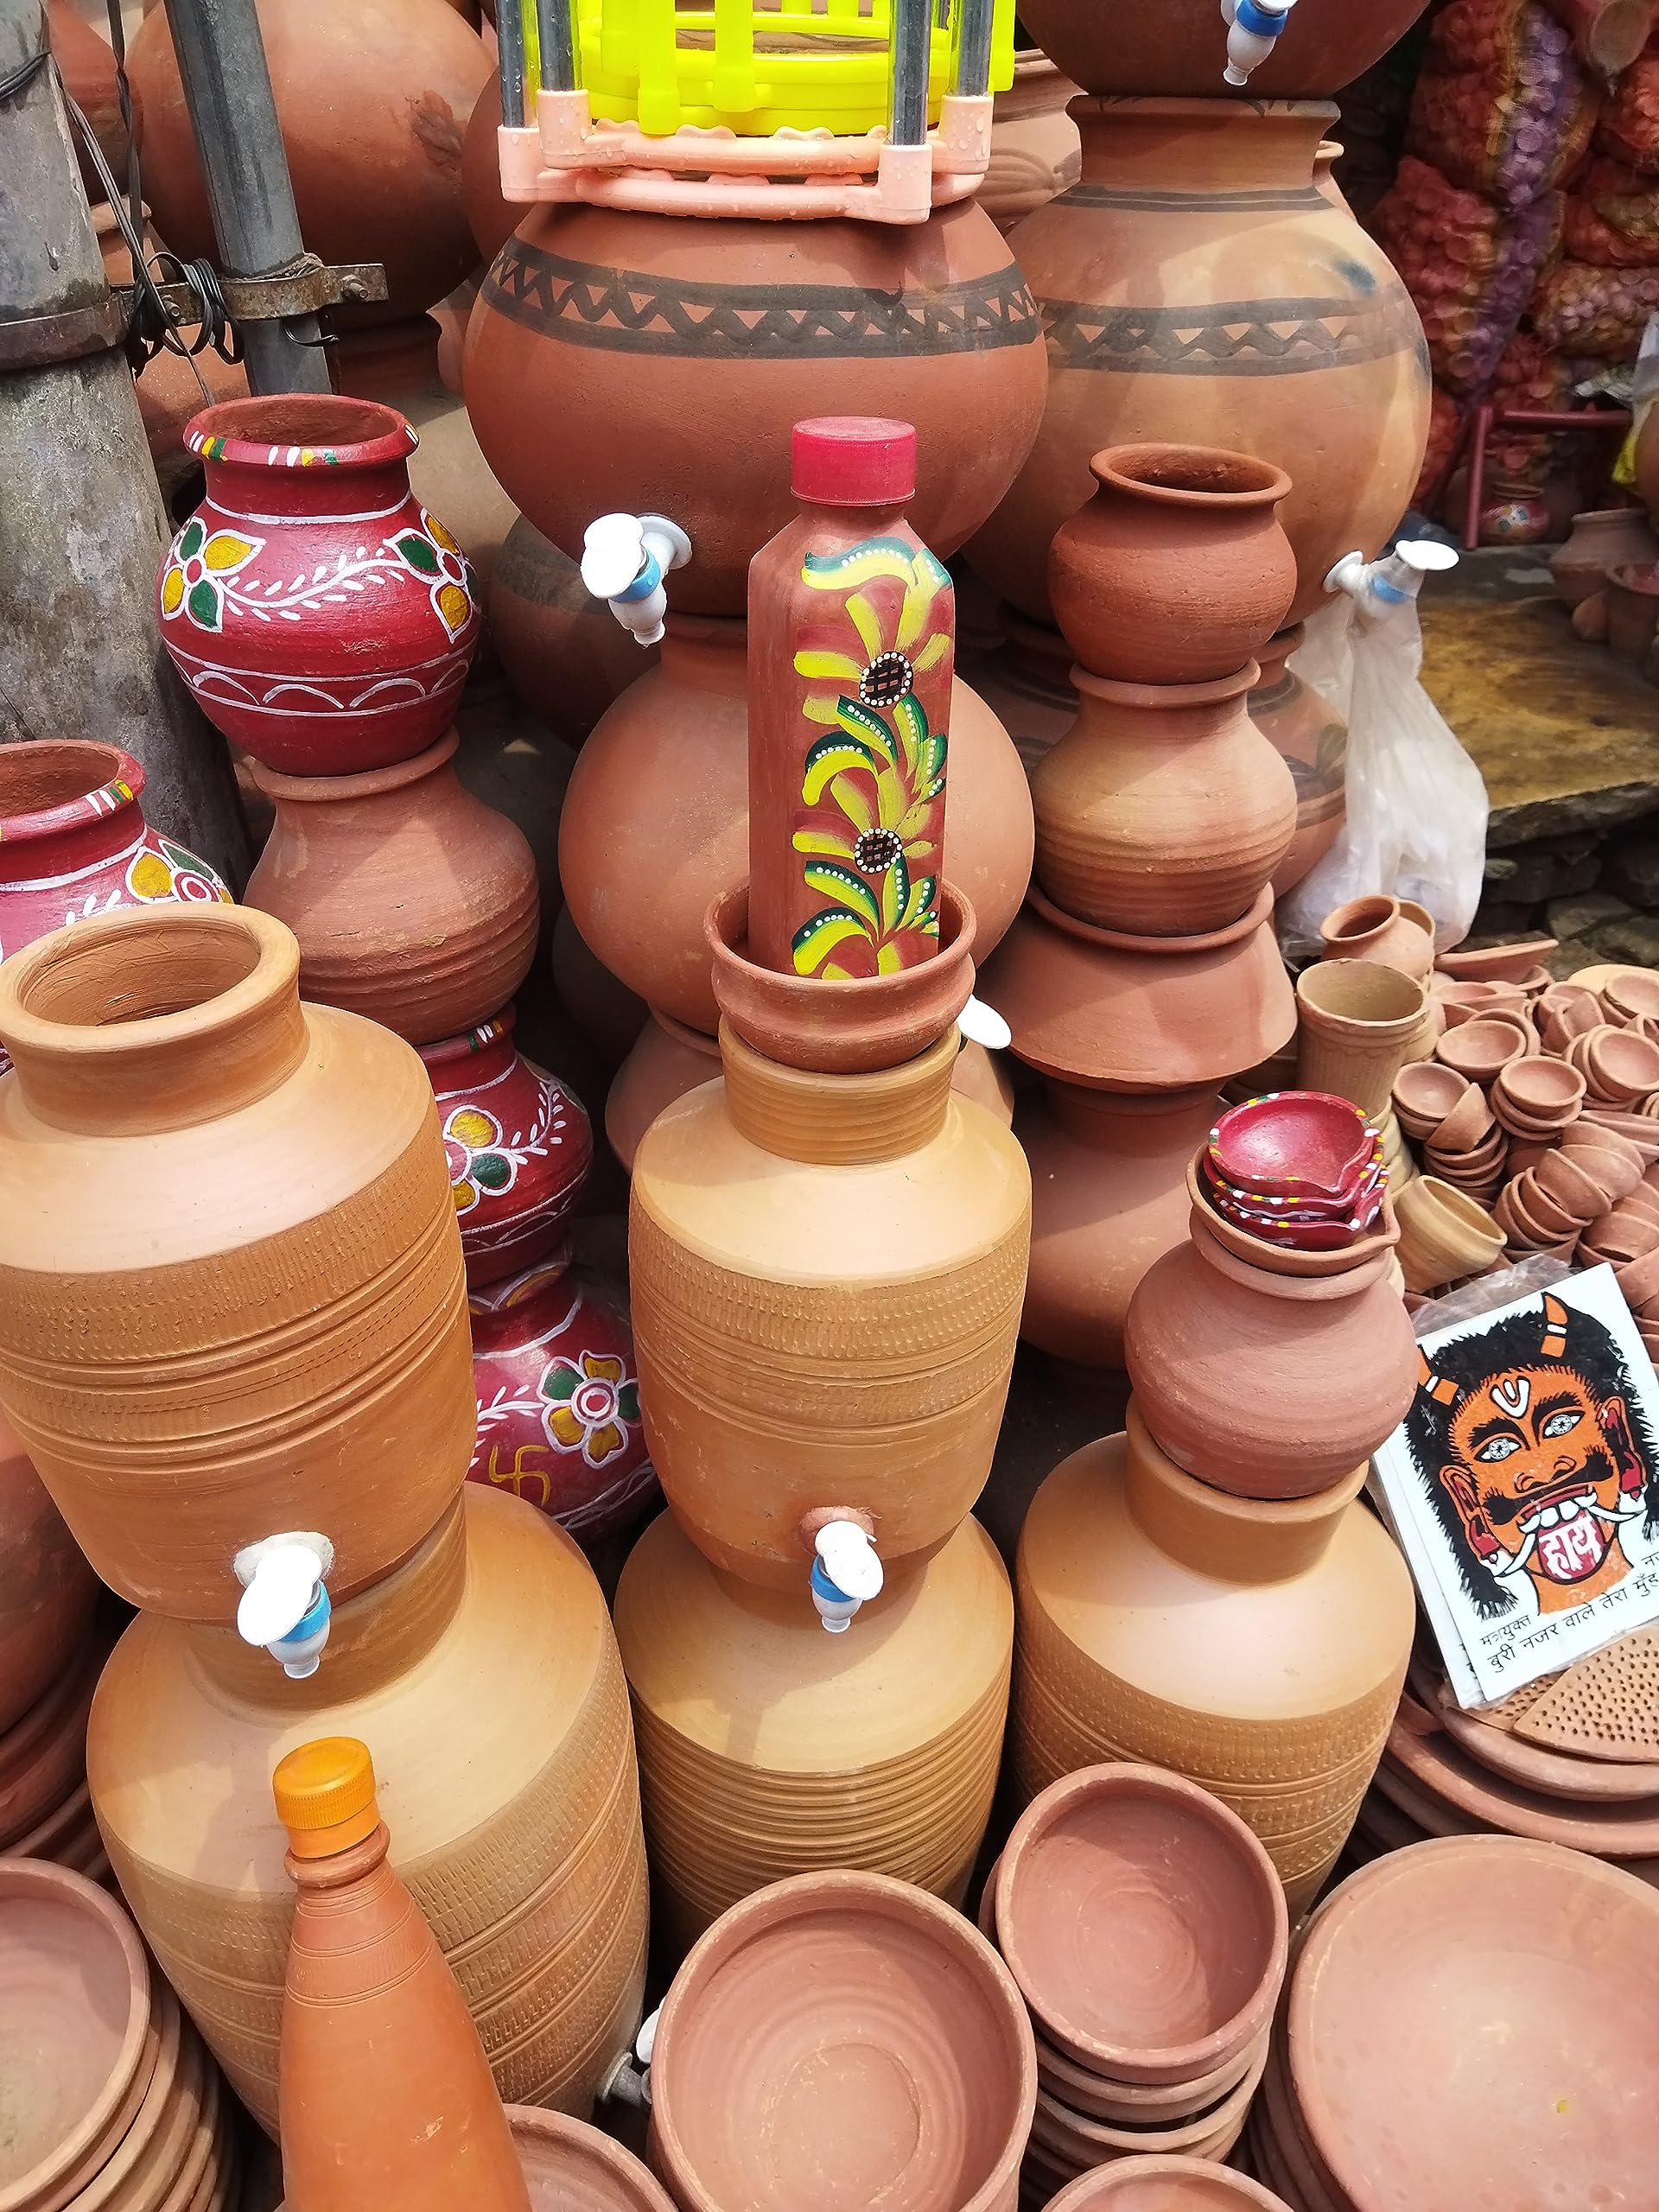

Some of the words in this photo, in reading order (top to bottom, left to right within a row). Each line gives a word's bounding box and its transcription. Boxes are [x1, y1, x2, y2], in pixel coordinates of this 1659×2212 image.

[1538, 1514, 1603, 1580] हाय
[1487, 1643, 1516, 1673] बुरी
[1519, 1623, 1559, 1649] नजर
[1561, 1602, 1595, 1626] वाले
[1599, 1587, 1628, 1608] तेरा
